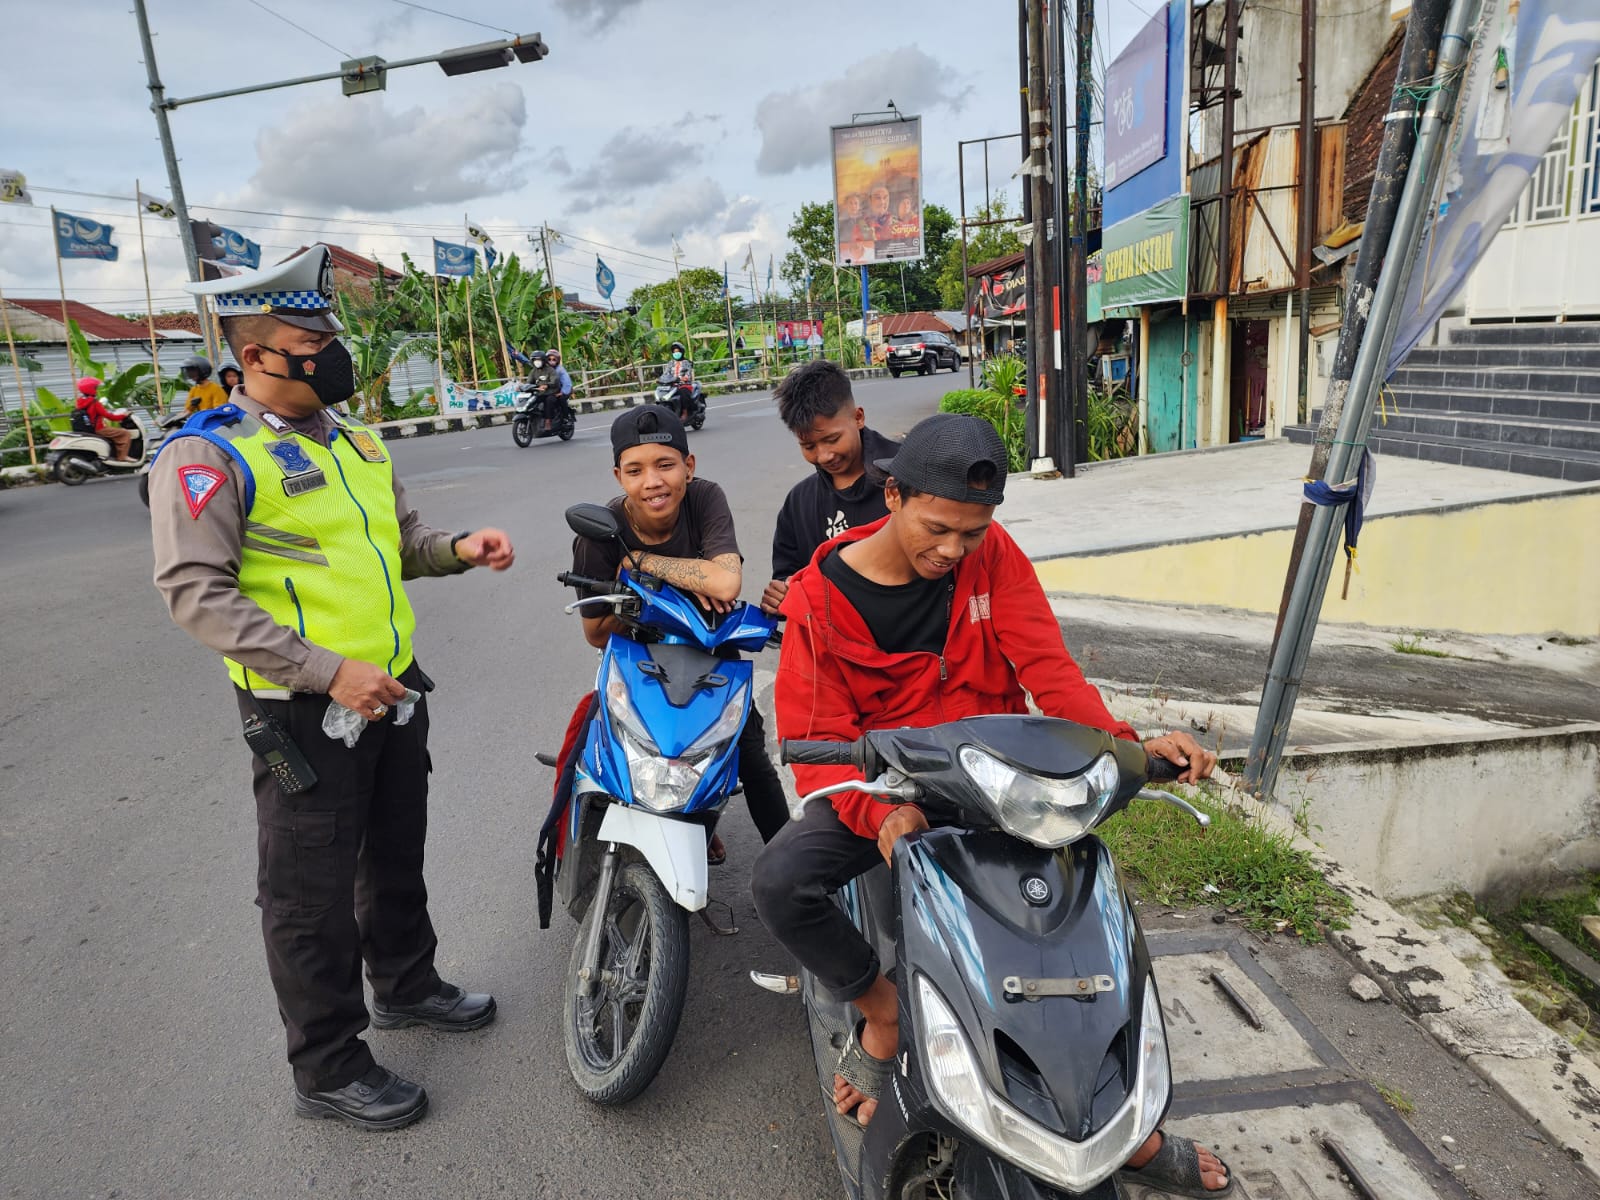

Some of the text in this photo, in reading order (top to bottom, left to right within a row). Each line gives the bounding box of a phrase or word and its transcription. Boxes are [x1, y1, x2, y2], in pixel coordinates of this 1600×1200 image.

[59, 218, 73, 238] 5
[438, 246, 446, 260] 5
[1105, 230, 1174, 284] SEPEDA LISTRIK
[449, 401, 464, 409] PKB
[892, 1071, 909, 1123] YAMAHA
